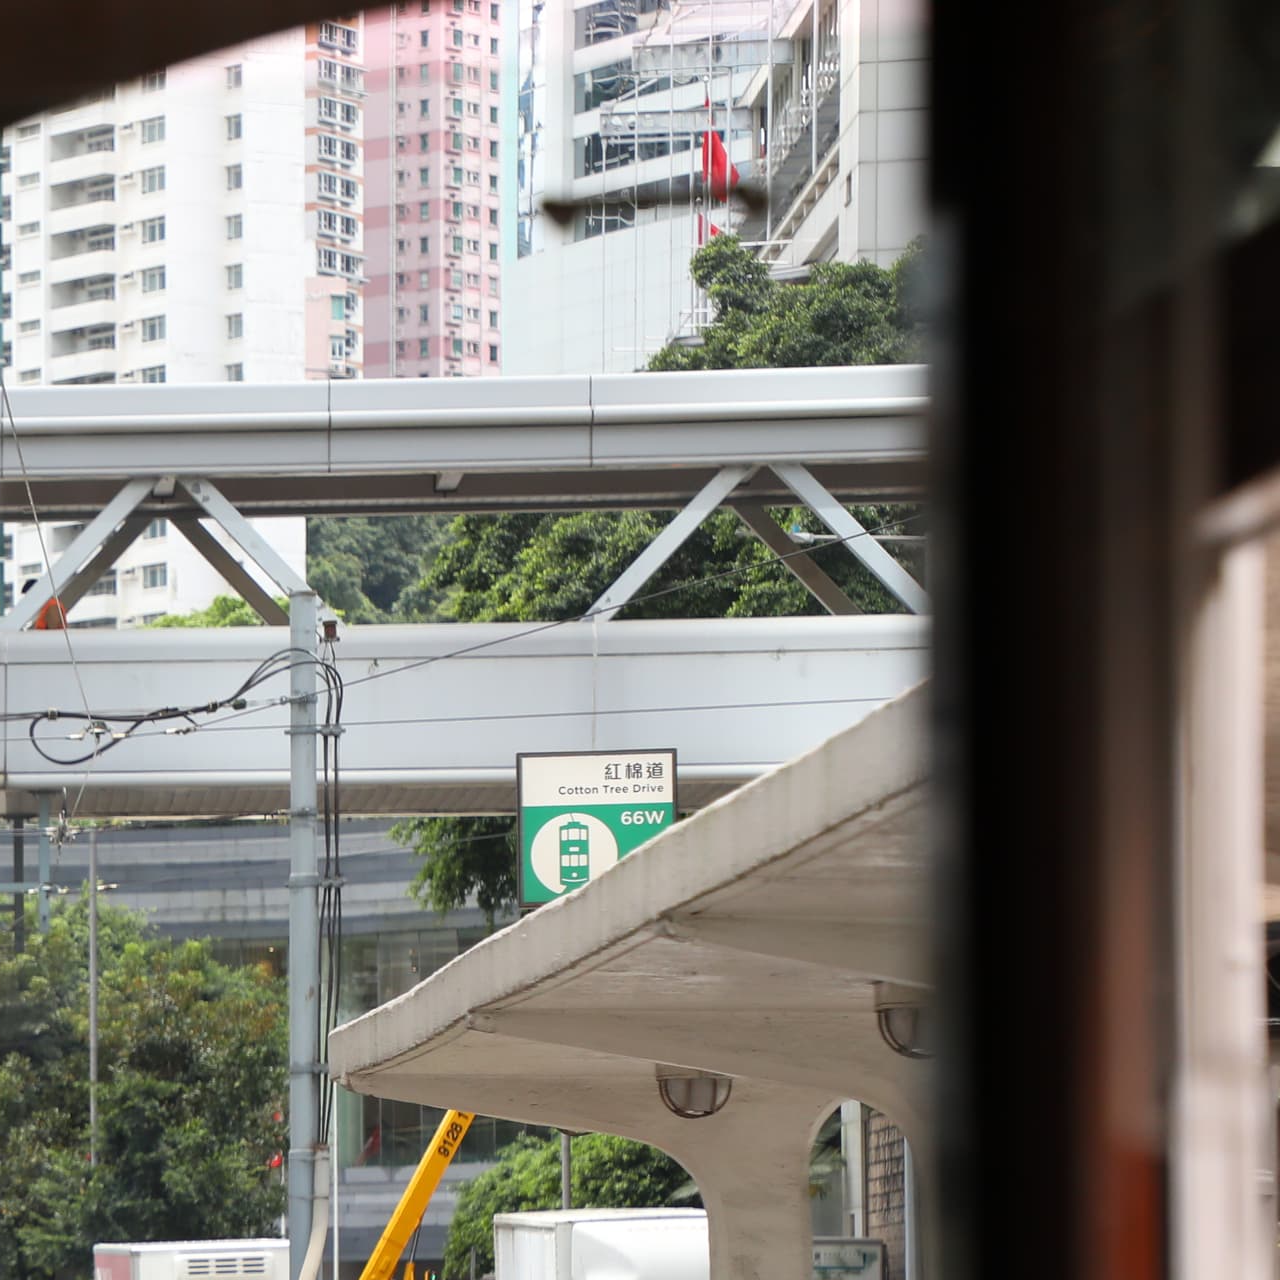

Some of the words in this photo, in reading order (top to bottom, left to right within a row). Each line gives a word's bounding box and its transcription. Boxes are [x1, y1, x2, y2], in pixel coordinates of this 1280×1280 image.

[604, 762, 664, 781] 紅棉道
[558, 786, 599, 796] Cotton
[603, 785, 629, 794] Tree
[633, 783, 665, 793] Drive
[621, 810, 665, 825] 66W
